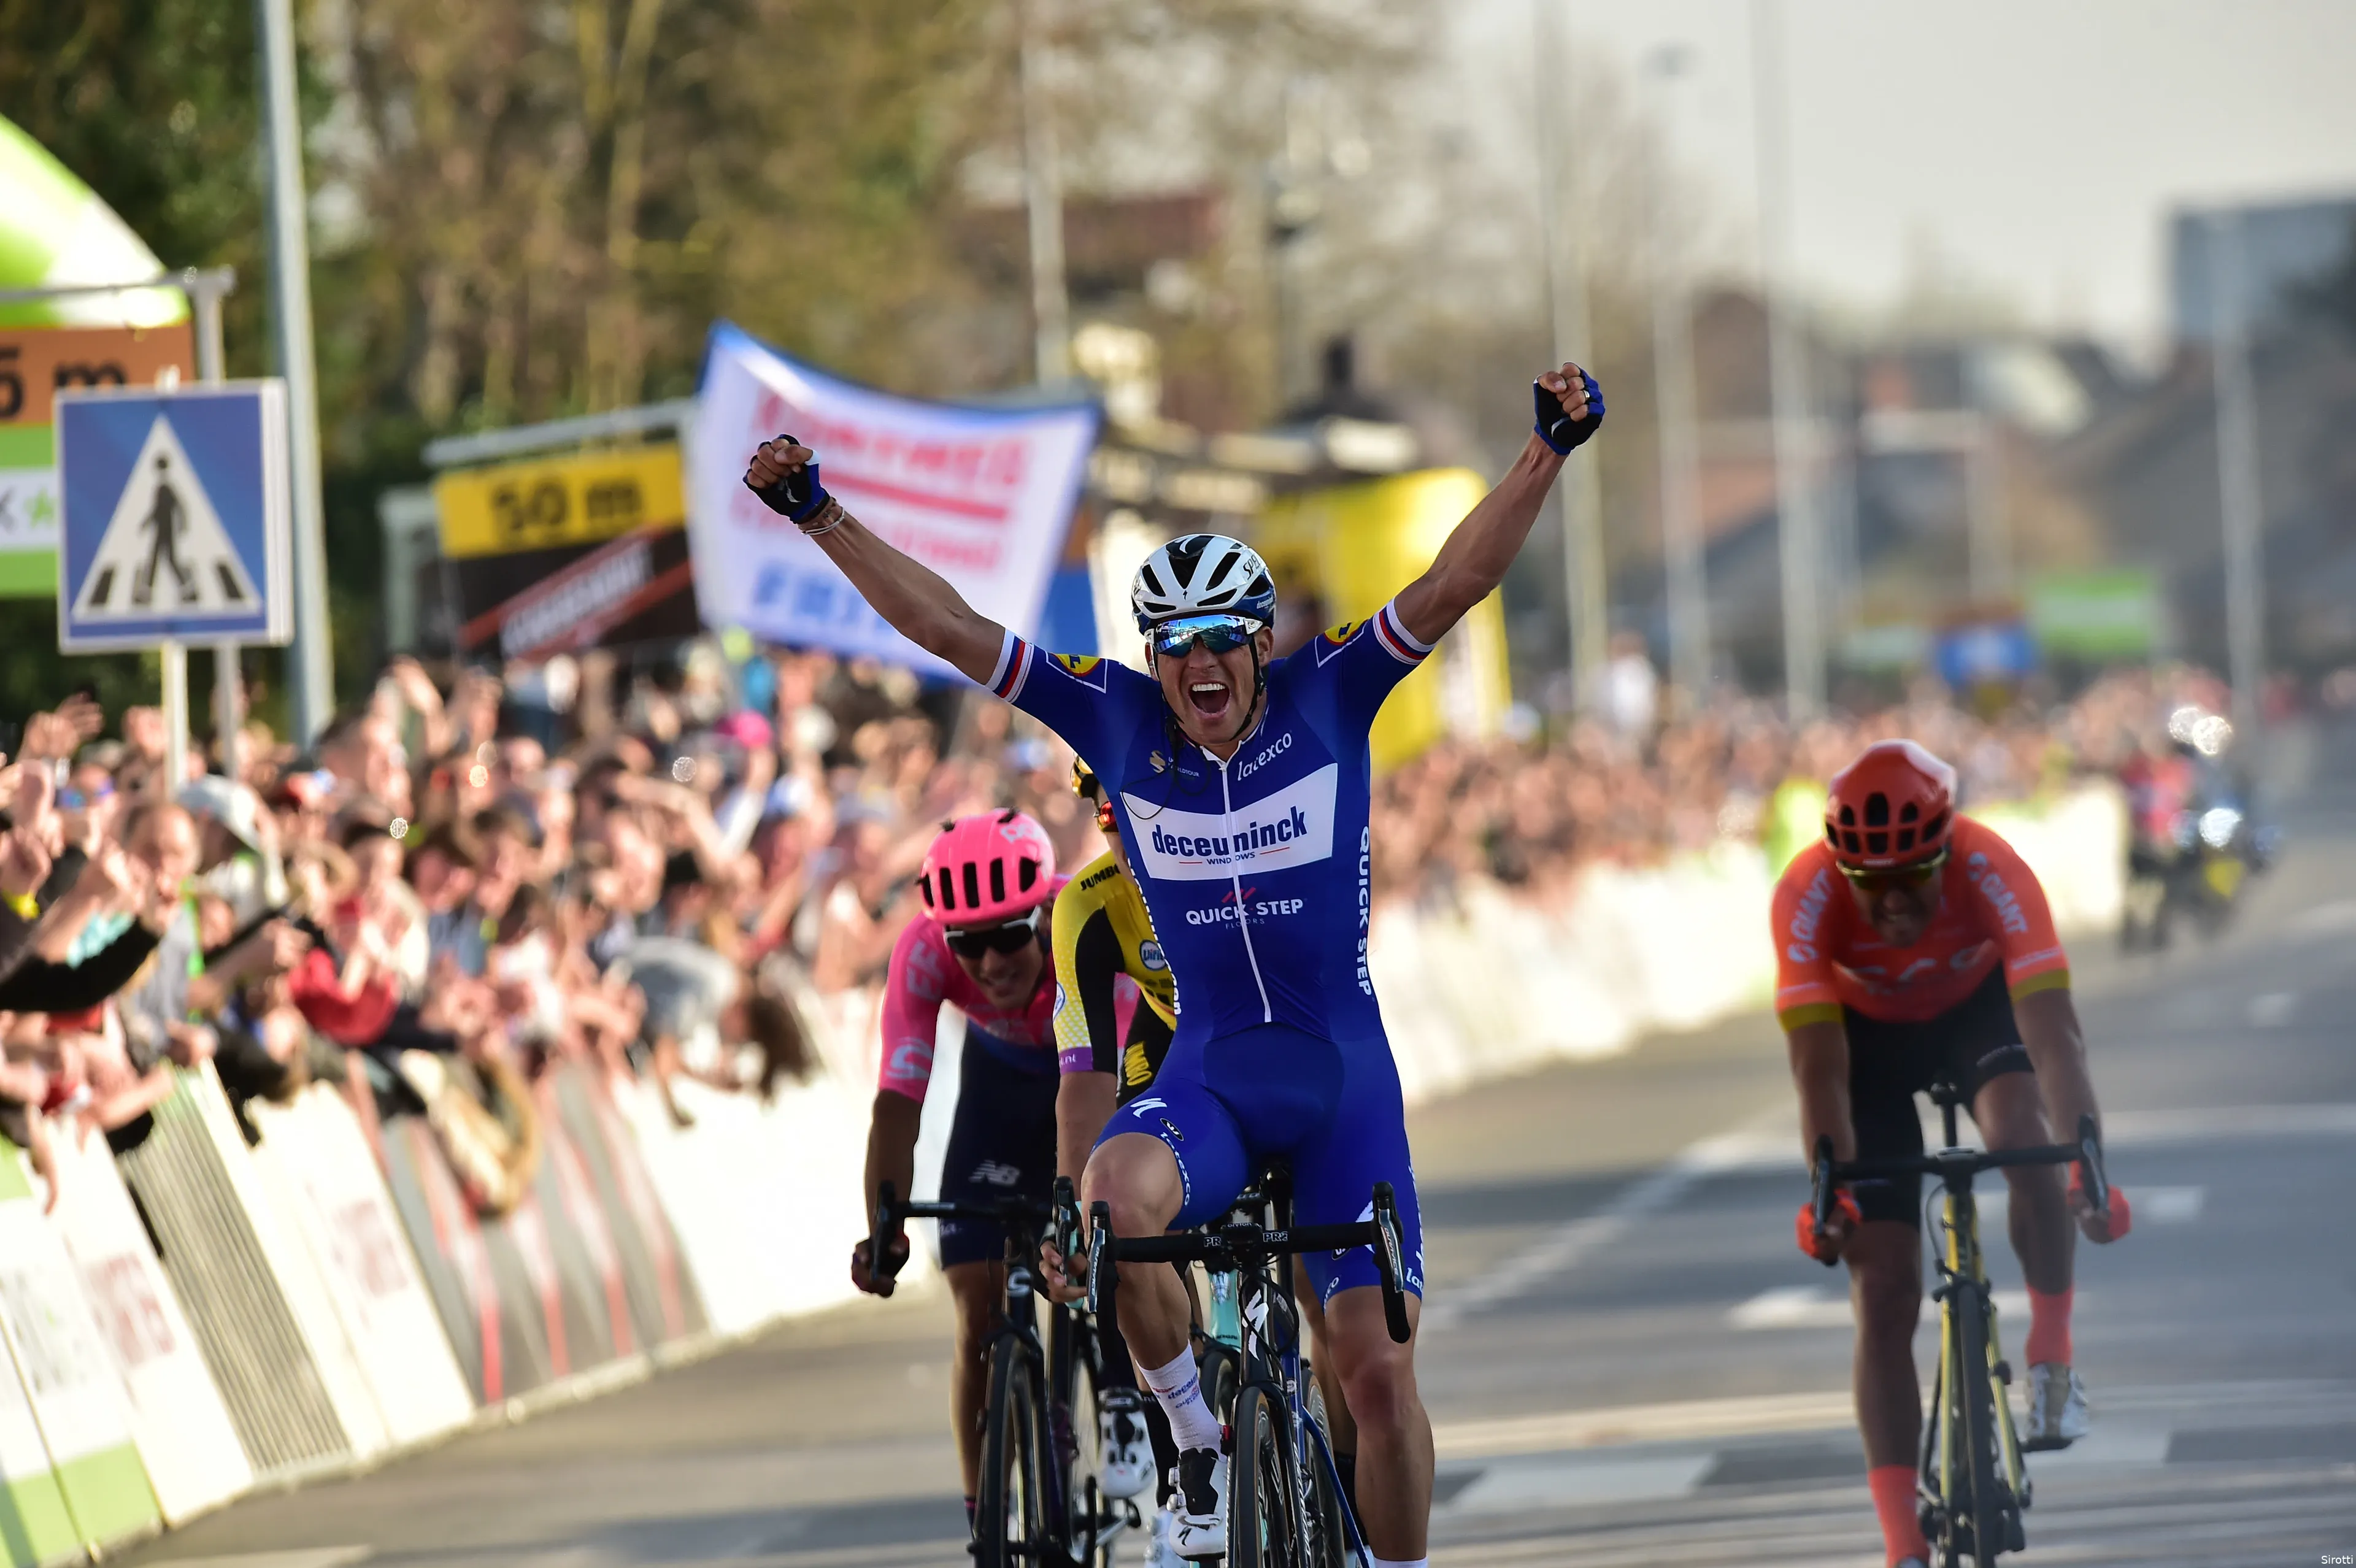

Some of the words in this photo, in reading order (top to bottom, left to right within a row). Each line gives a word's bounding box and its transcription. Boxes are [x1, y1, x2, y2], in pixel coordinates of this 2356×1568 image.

[1237, 732, 1293, 782] latexco
[1151, 805, 1307, 857] deceuninck
[1206, 851, 1256, 865] WINDOWS
[1358, 825, 1370, 929] QUICK
[1185, 904, 1250, 925] QUICK
[1256, 898, 1304, 915] STEP
[1357, 937, 1372, 996] STEP
[1160, 1131, 1191, 1206] latexco
